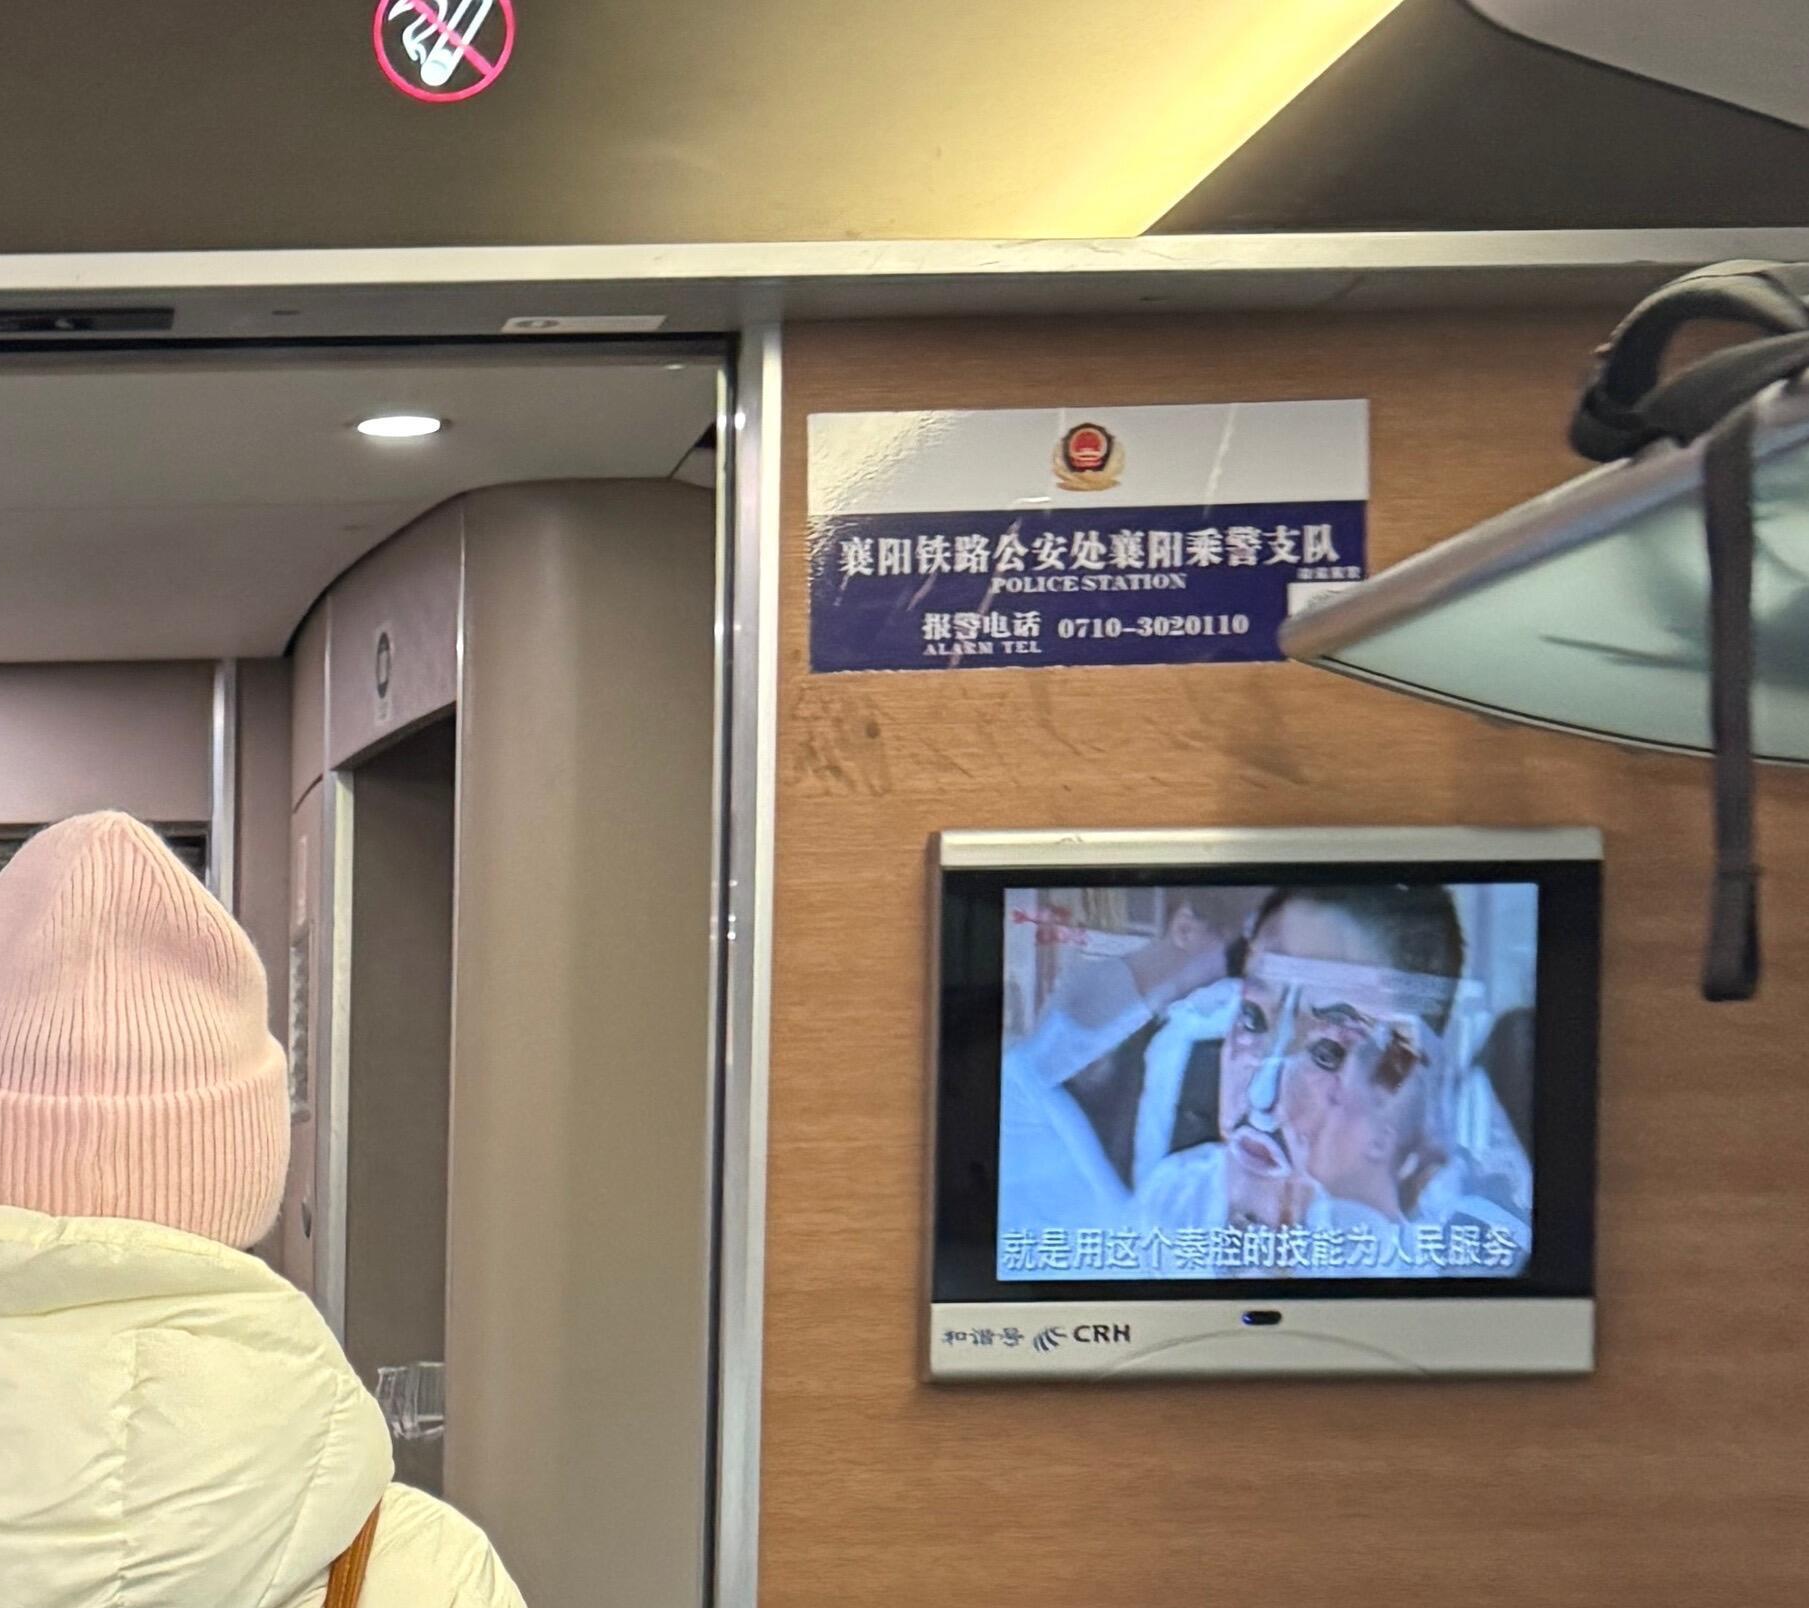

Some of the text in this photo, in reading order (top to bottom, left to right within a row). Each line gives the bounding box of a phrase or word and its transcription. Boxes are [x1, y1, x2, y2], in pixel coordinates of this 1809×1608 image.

[839, 523, 1340, 577] 襄阳铁路公安处襄阳乘警支队
[992, 572, 1188, 594] POLICE STATION
[921, 610, 1250, 640] 报警电话 0710-3020110
[1002, 640, 1042, 654] TEL
[1073, 1324, 1131, 1343] CRH
